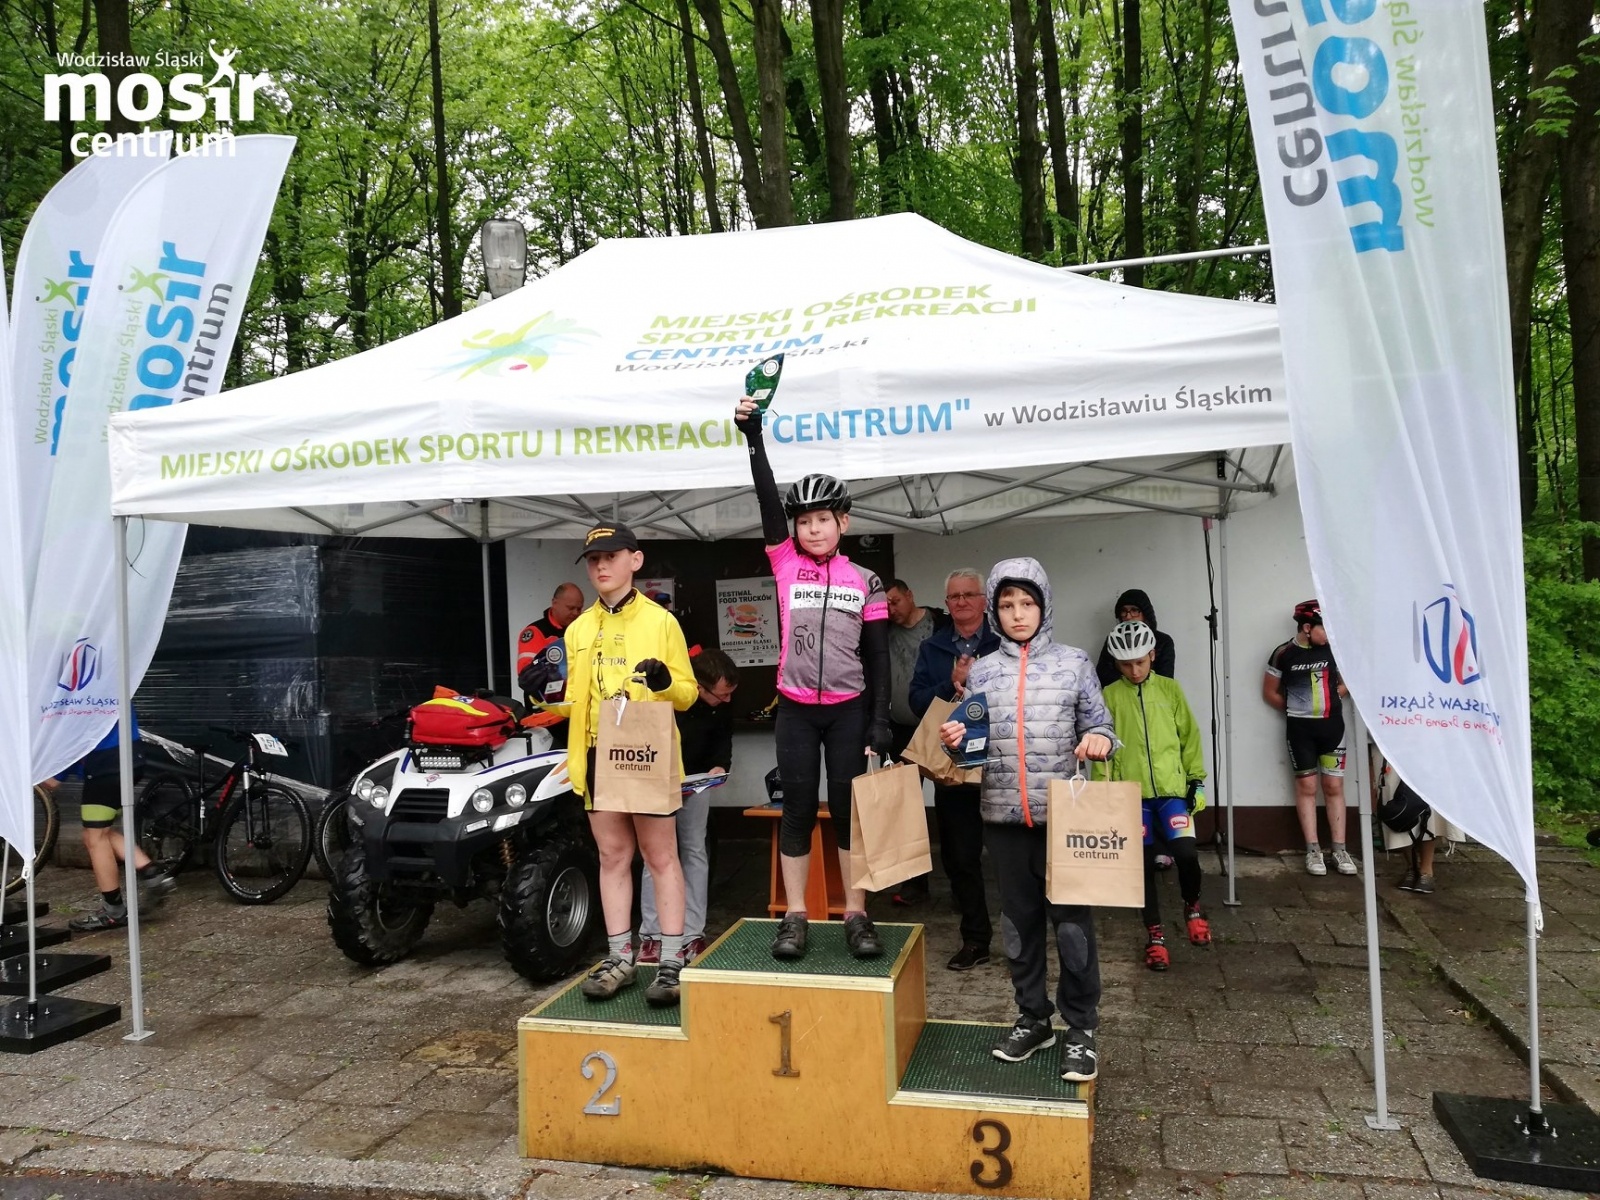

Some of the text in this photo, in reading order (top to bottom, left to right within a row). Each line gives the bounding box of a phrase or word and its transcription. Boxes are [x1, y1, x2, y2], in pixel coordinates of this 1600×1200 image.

[650, 284, 992, 329] MIEJSKI OŚRODEK
[637, 324, 791, 344] SPORTU
[825, 298, 1036, 328] REKREACJI
[625, 333, 823, 361] CENTRUM
[161, 449, 263, 479] MIEJSKI
[270, 439, 409, 472] OŚRODEK
[419, 430, 543, 463] SPORTU
[555, 428, 562, 456] I
[573, 419, 743, 455] REKREACJI
[984, 412, 1004, 427] w
[1011, 394, 1167, 425] Wodzisławiu
[1175, 384, 1272, 411] Śląskim
[718, 590, 752, 598] FESTIWAL
[738, 594, 772, 603] TRUCKÓW
[1291, 661, 1328, 671] SILVINI
[609, 747, 658, 762] mosir
[615, 763, 651, 771] centrum
[1066, 834, 1128, 850] mosir
[1073, 851, 1119, 859] centrum
[768, 1009, 800, 1078] 1
[580, 1051, 621, 1116] 2
[969, 1118, 1013, 1189] 3
